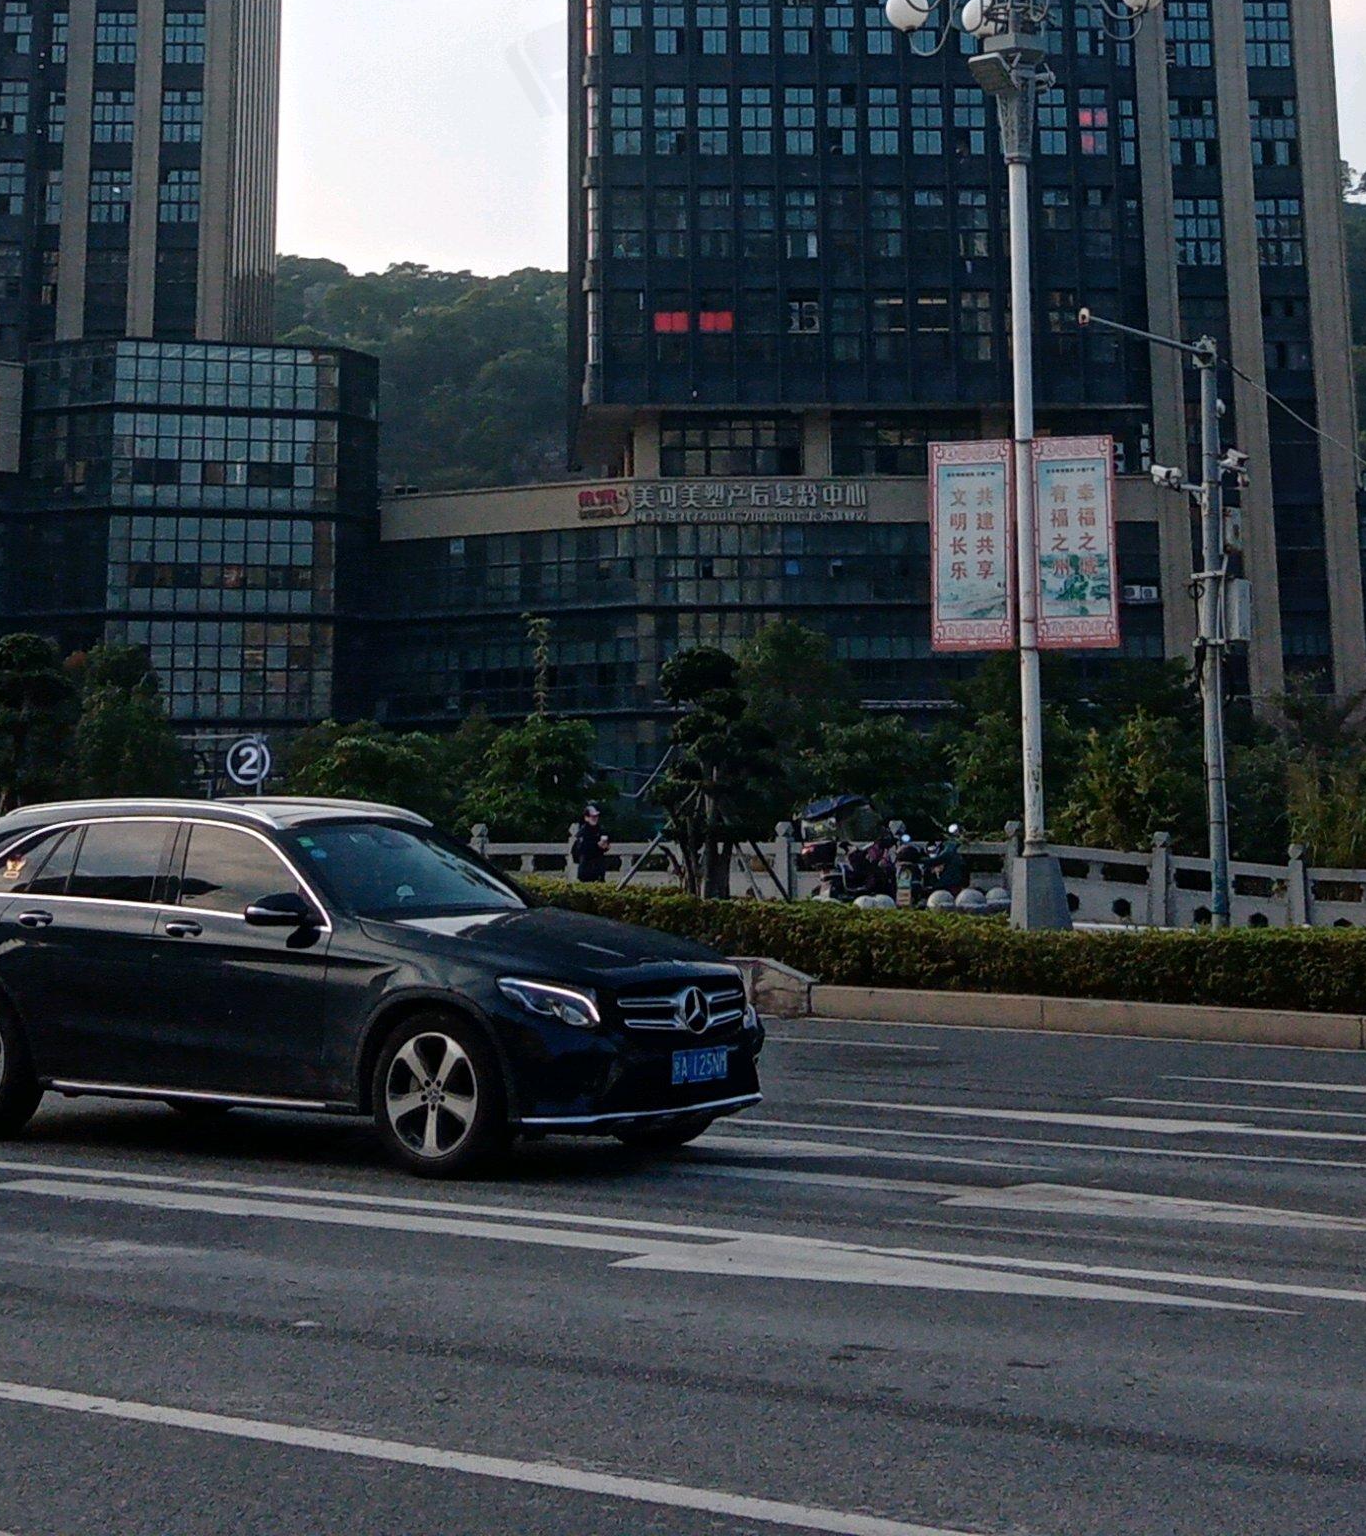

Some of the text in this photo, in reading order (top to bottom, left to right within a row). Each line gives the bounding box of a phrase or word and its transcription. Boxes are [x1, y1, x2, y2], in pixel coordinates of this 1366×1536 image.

[949, 487, 968, 581] 文明长乐
[975, 486, 994, 579] 共建共享
[1049, 484, 1070, 577] 有福之州
